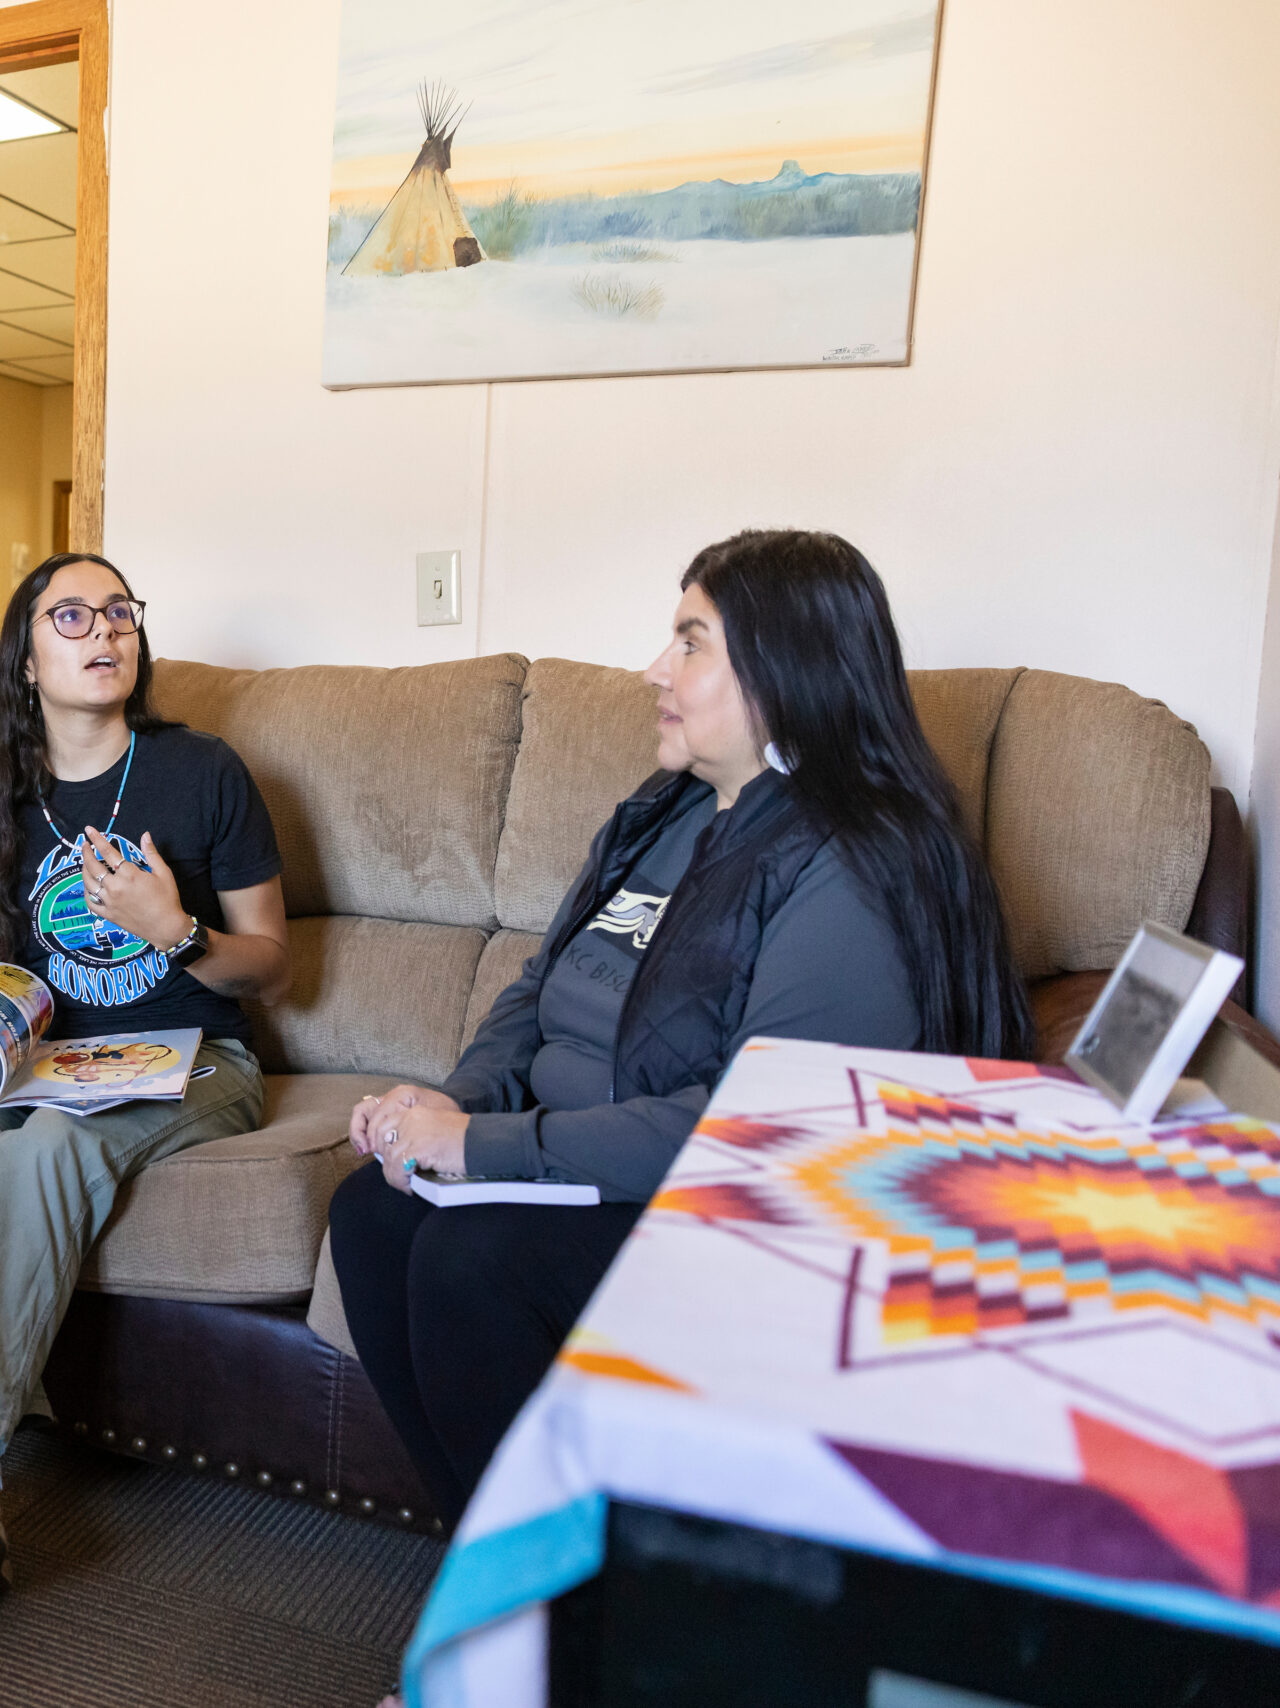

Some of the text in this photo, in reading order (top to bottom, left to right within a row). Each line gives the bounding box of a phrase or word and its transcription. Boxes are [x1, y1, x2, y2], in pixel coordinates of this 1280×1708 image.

[29, 833, 153, 901] LAE
[60, 870, 70, 878] THE
[48, 950, 169, 1007] HONORING
